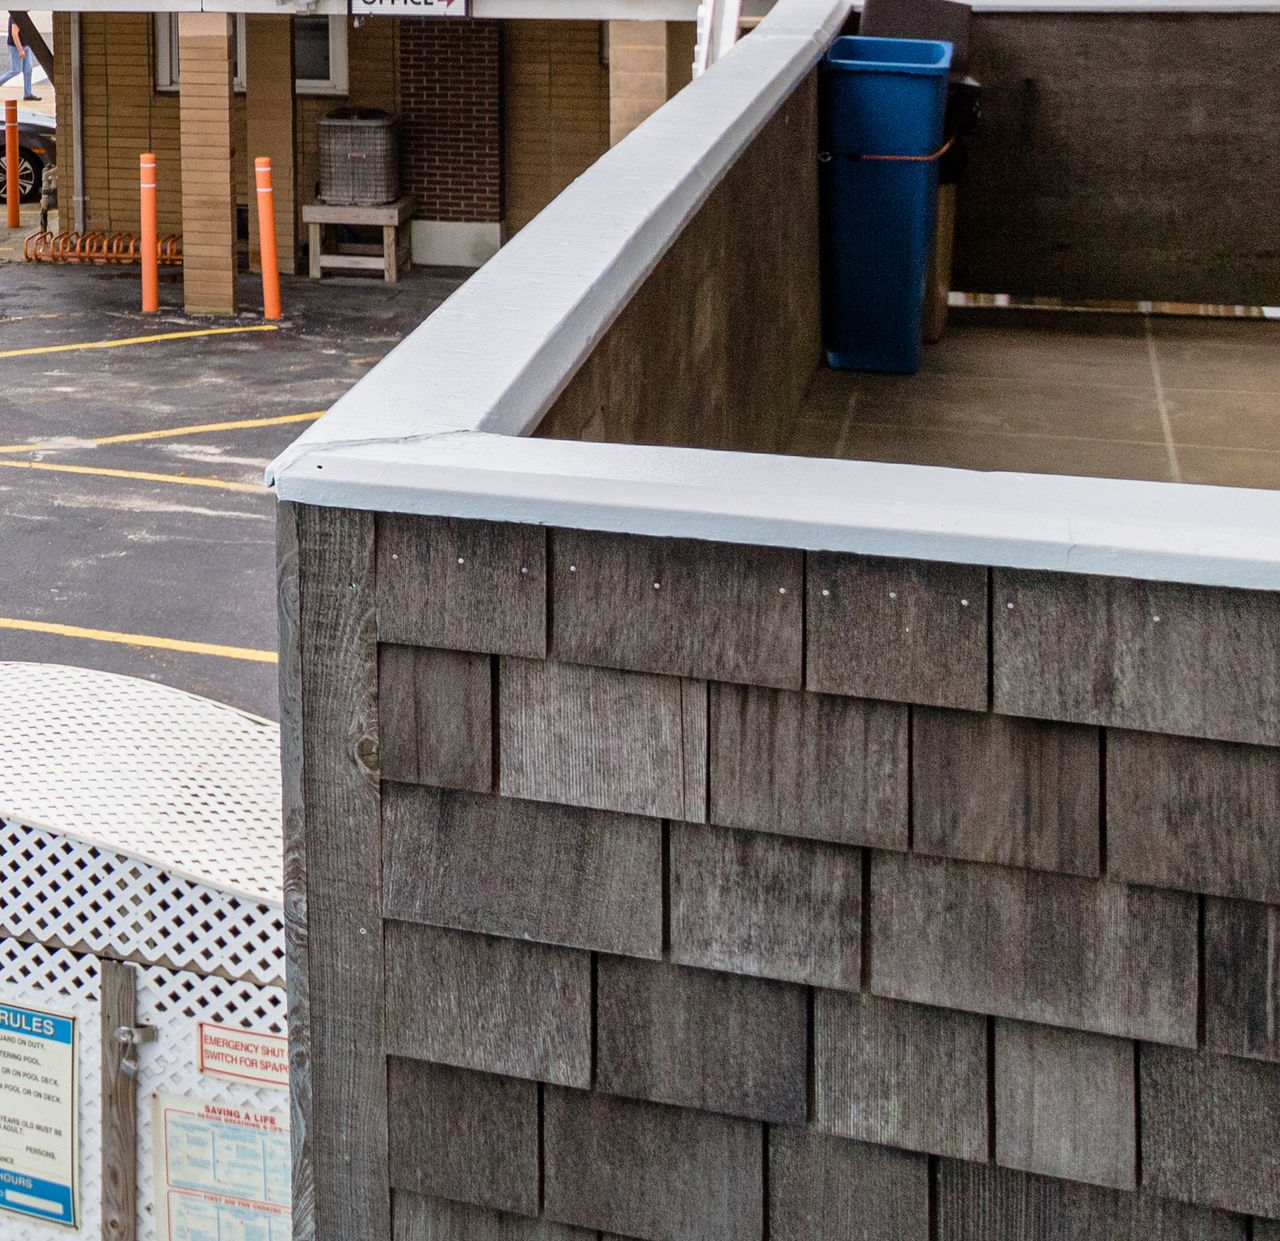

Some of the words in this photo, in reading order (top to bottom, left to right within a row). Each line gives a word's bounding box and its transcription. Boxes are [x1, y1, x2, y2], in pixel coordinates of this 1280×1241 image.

[17, 1038, 27, 1046] ON
[203, 1035, 259, 1054] EMERGENCY
[260, 1045, 285, 1058] SHUT
[204, 1049, 238, 1064] SWITCH
[239, 1057, 258, 1068] FOR
[12, 1069, 21, 1077] ON
[23, 1071, 39, 1082] POOL
[4, 1083, 21, 1094] POOL
[22, 1088, 32, 1096] OR
[33, 1090, 42, 1099] ON
[204, 1104, 240, 1119] SAVING
[244, 1112, 250, 1121] A
[254, 1114, 276, 1125] LIFE
[0, 1115, 20, 1126] YEARS
[21, 1121, 34, 1129] OLD
[35, 1124, 52, 1134] MUST
